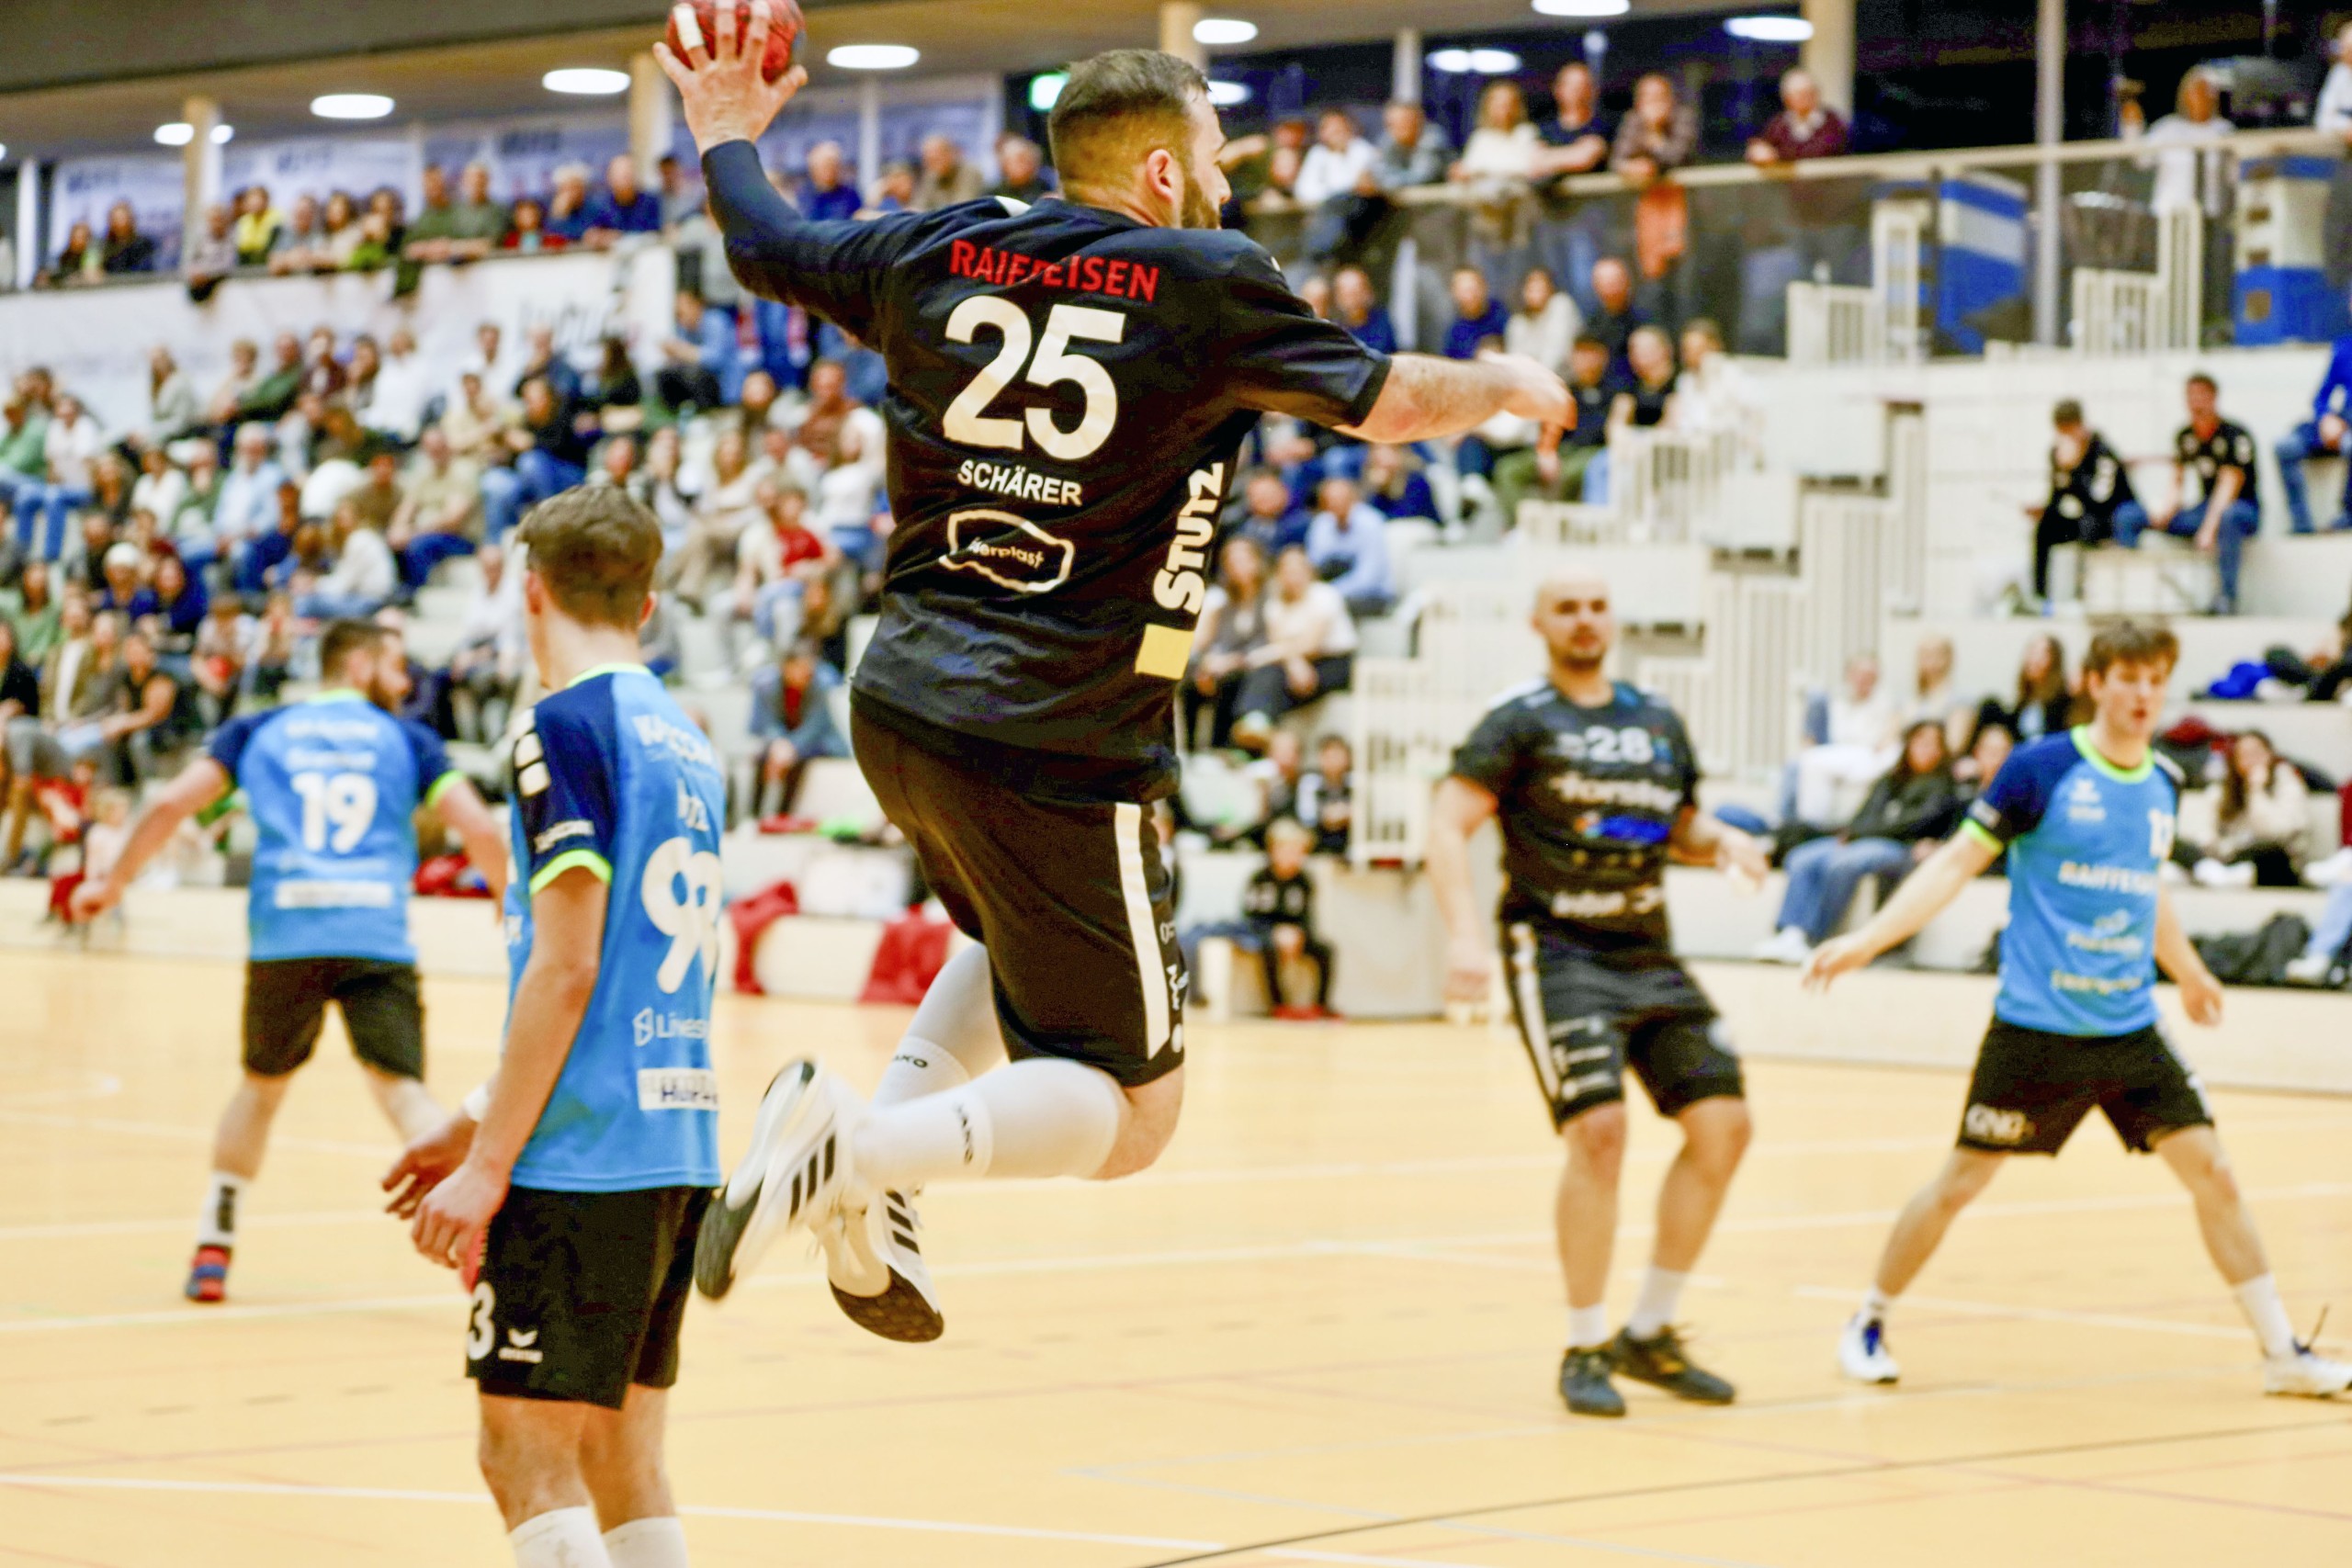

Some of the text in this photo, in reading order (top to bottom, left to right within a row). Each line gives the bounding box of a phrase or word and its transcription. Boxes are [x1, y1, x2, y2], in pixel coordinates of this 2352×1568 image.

[942, 294, 1126, 460] 25
[956, 458, 1084, 506] SCHÄRER
[1152, 462, 1224, 615] STUTZ
[1585, 725, 1653, 764] 28
[291, 771, 379, 855] 19
